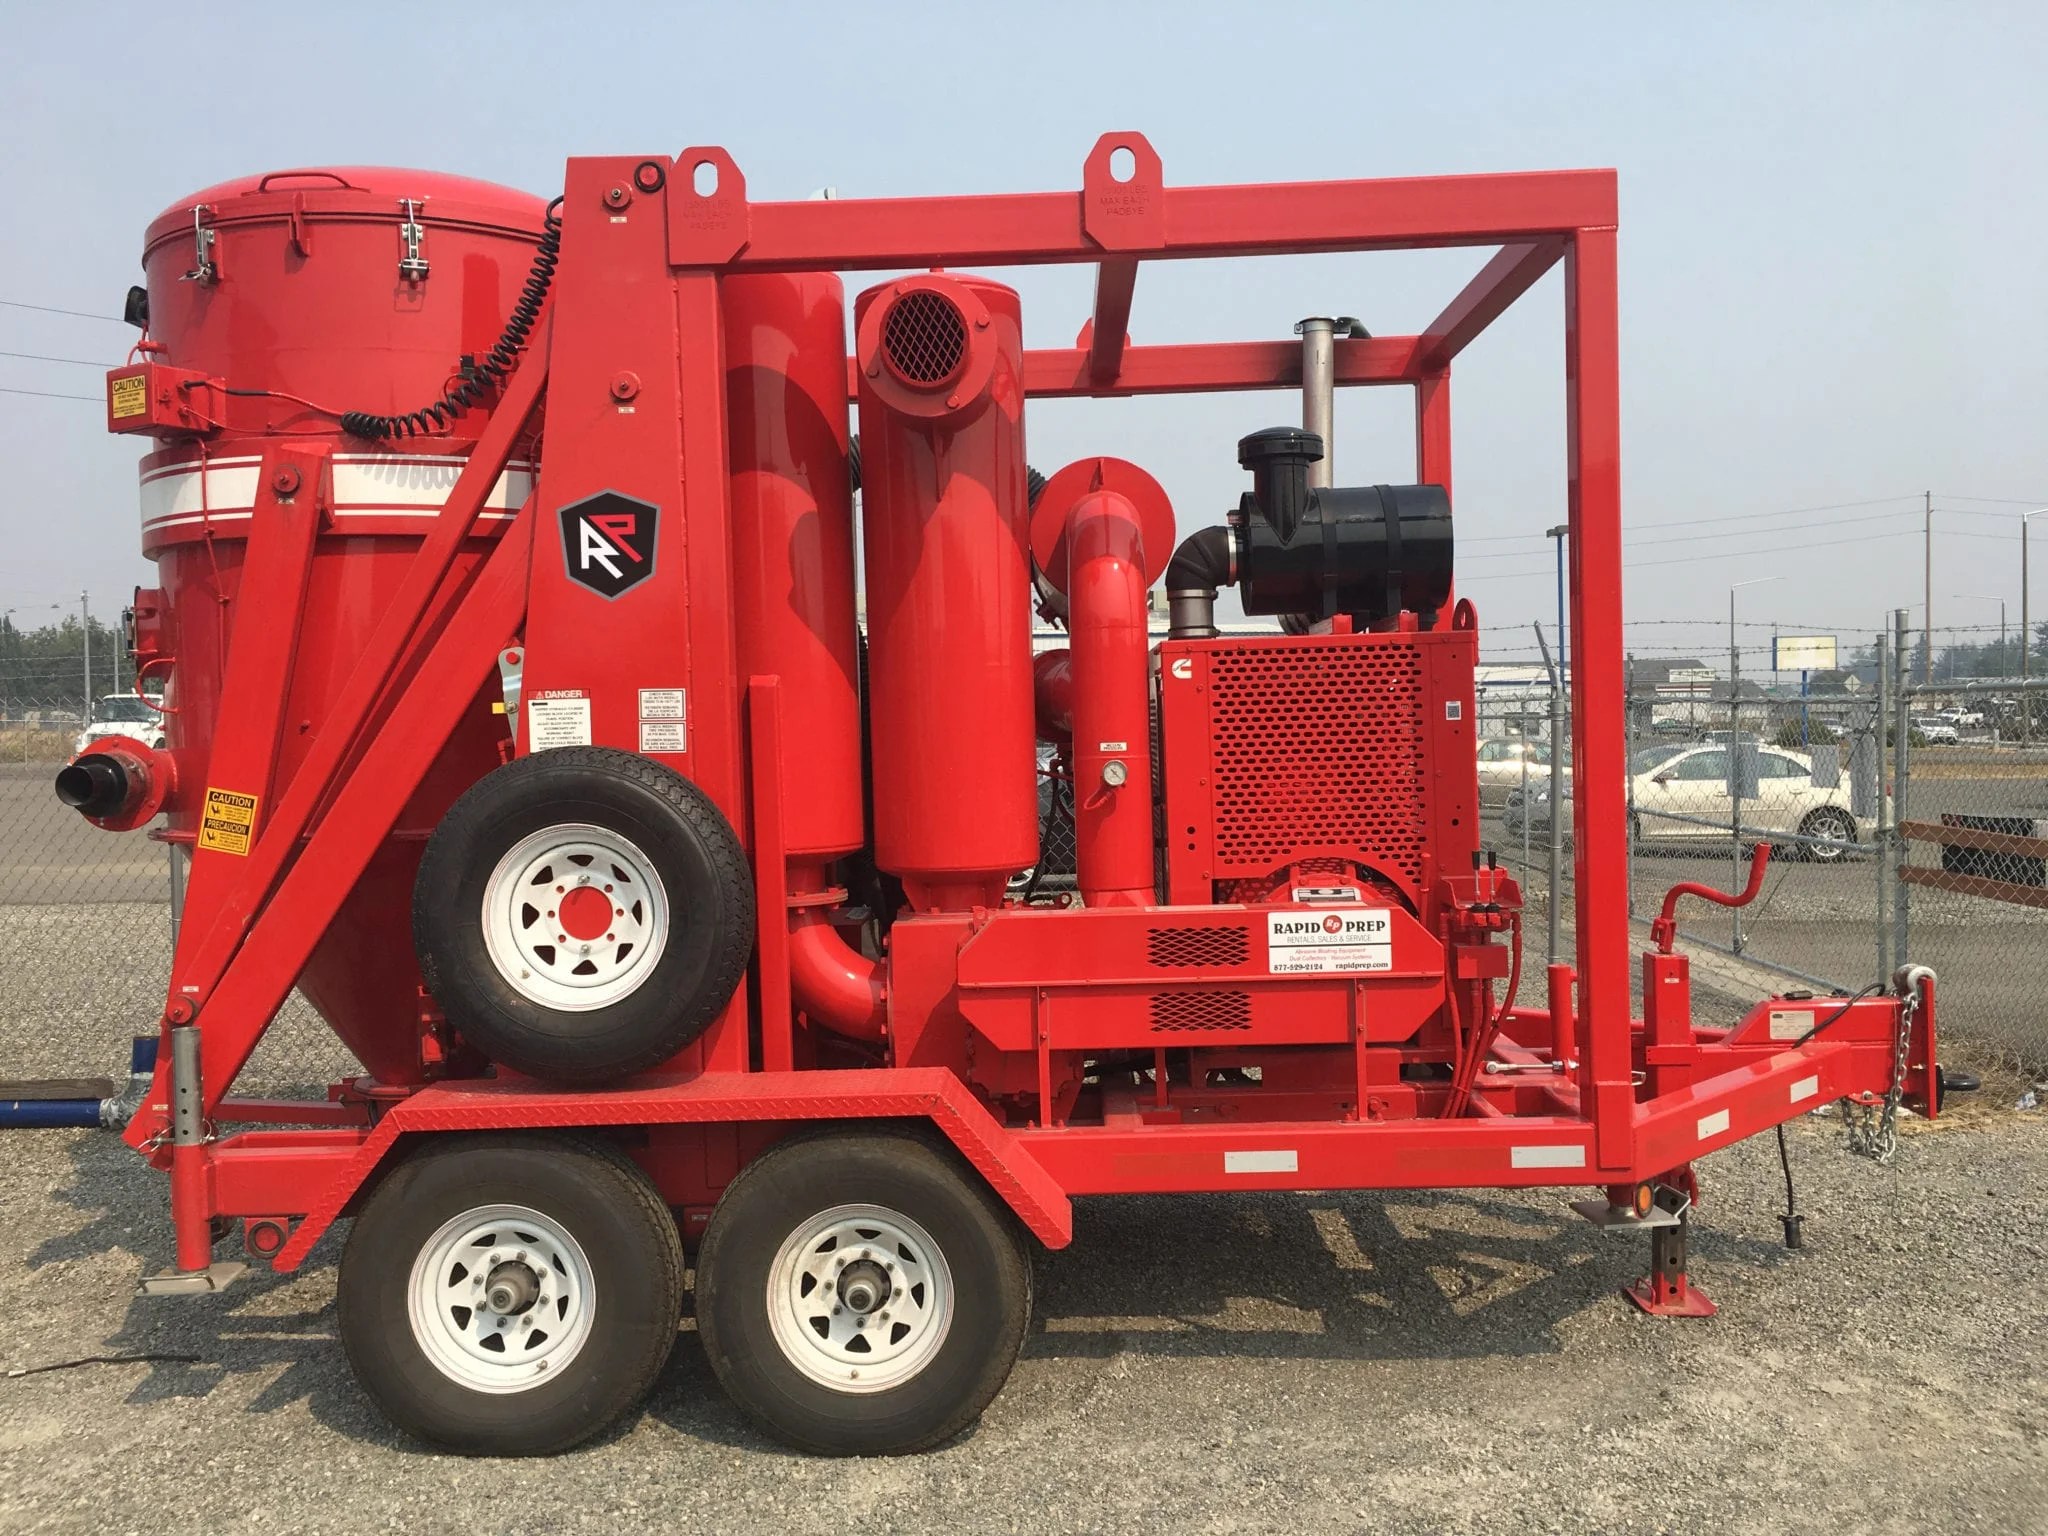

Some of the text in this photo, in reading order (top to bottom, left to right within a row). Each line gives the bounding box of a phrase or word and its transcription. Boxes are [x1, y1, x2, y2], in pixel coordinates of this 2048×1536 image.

[113, 377, 144, 392] CAUTION
[544, 689, 583, 699] DANGER
[211, 792, 252, 808] CAUTION
[207, 819, 247, 834] PRECAUCION
[1273, 922, 1321, 934] RAPID
[1345, 920, 1386, 933] PREP
[1317, 935, 1338, 943] SALES
[1345, 934, 1372, 943] SERVICE
[1273, 962, 1389, 971] 877-529-2124 rapidprep.com
